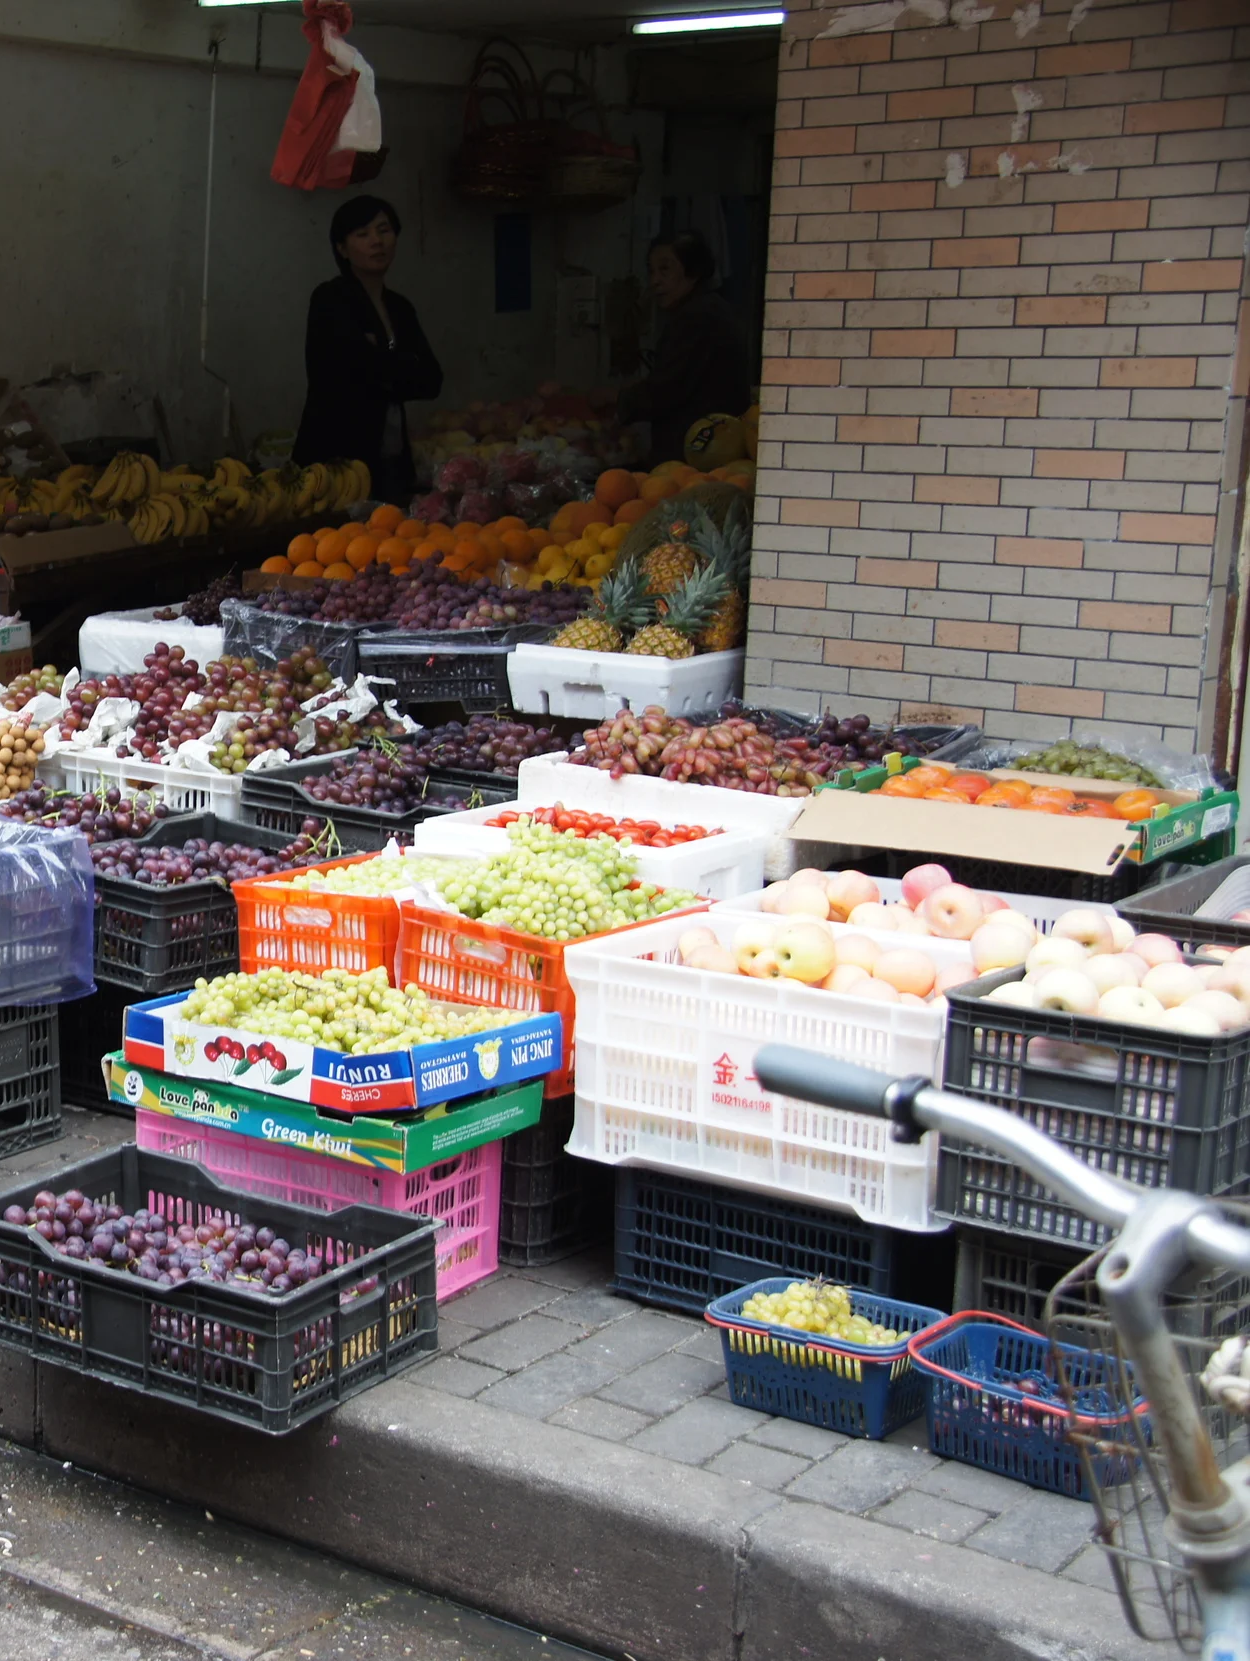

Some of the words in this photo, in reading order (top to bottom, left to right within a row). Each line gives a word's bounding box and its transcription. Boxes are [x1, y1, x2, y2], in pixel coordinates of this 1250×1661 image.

[511, 1044, 528, 1067] PIN
[529, 1037, 554, 1062] JING
[421, 1061, 469, 1092] CHERRIES
[160, 1086, 189, 1106] Love
[261, 1117, 308, 1145] Green
[311, 1130, 352, 1157] Kiwi
